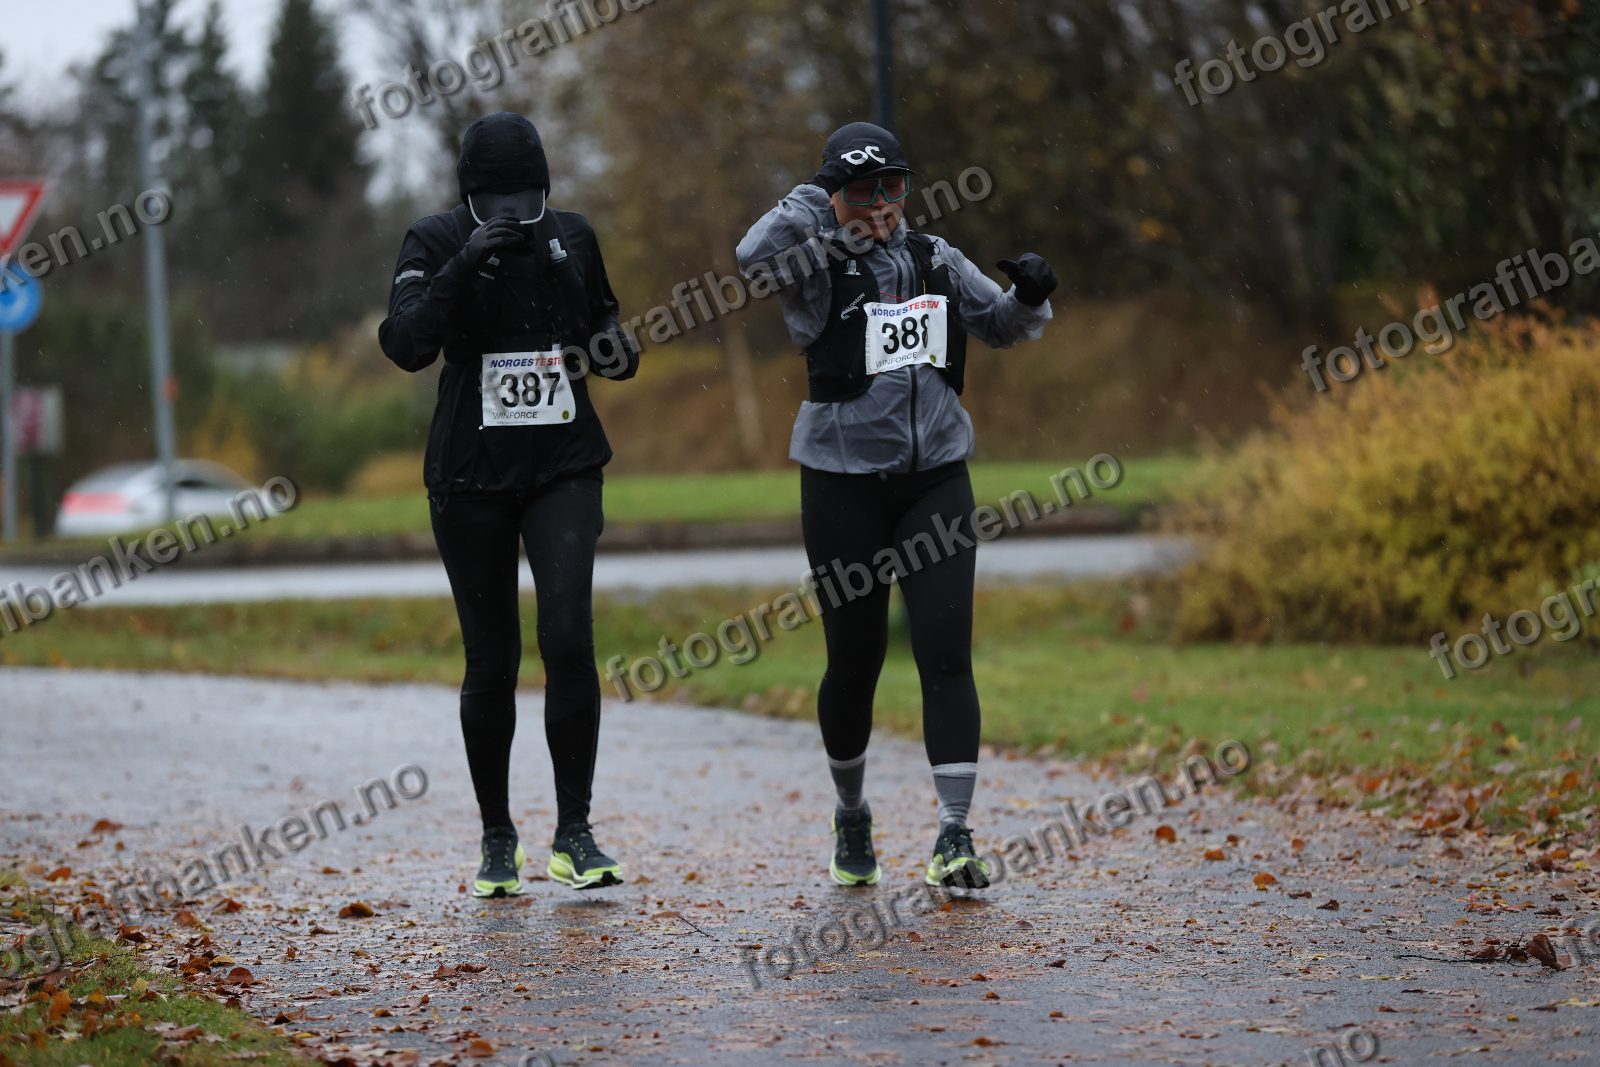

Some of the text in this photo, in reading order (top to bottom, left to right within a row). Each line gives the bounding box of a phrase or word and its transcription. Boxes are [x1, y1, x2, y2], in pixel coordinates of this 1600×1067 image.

[875, 351, 918, 368] WINFORCE
[500, 371, 561, 408] 387
[492, 411, 539, 420] WINFORCE
